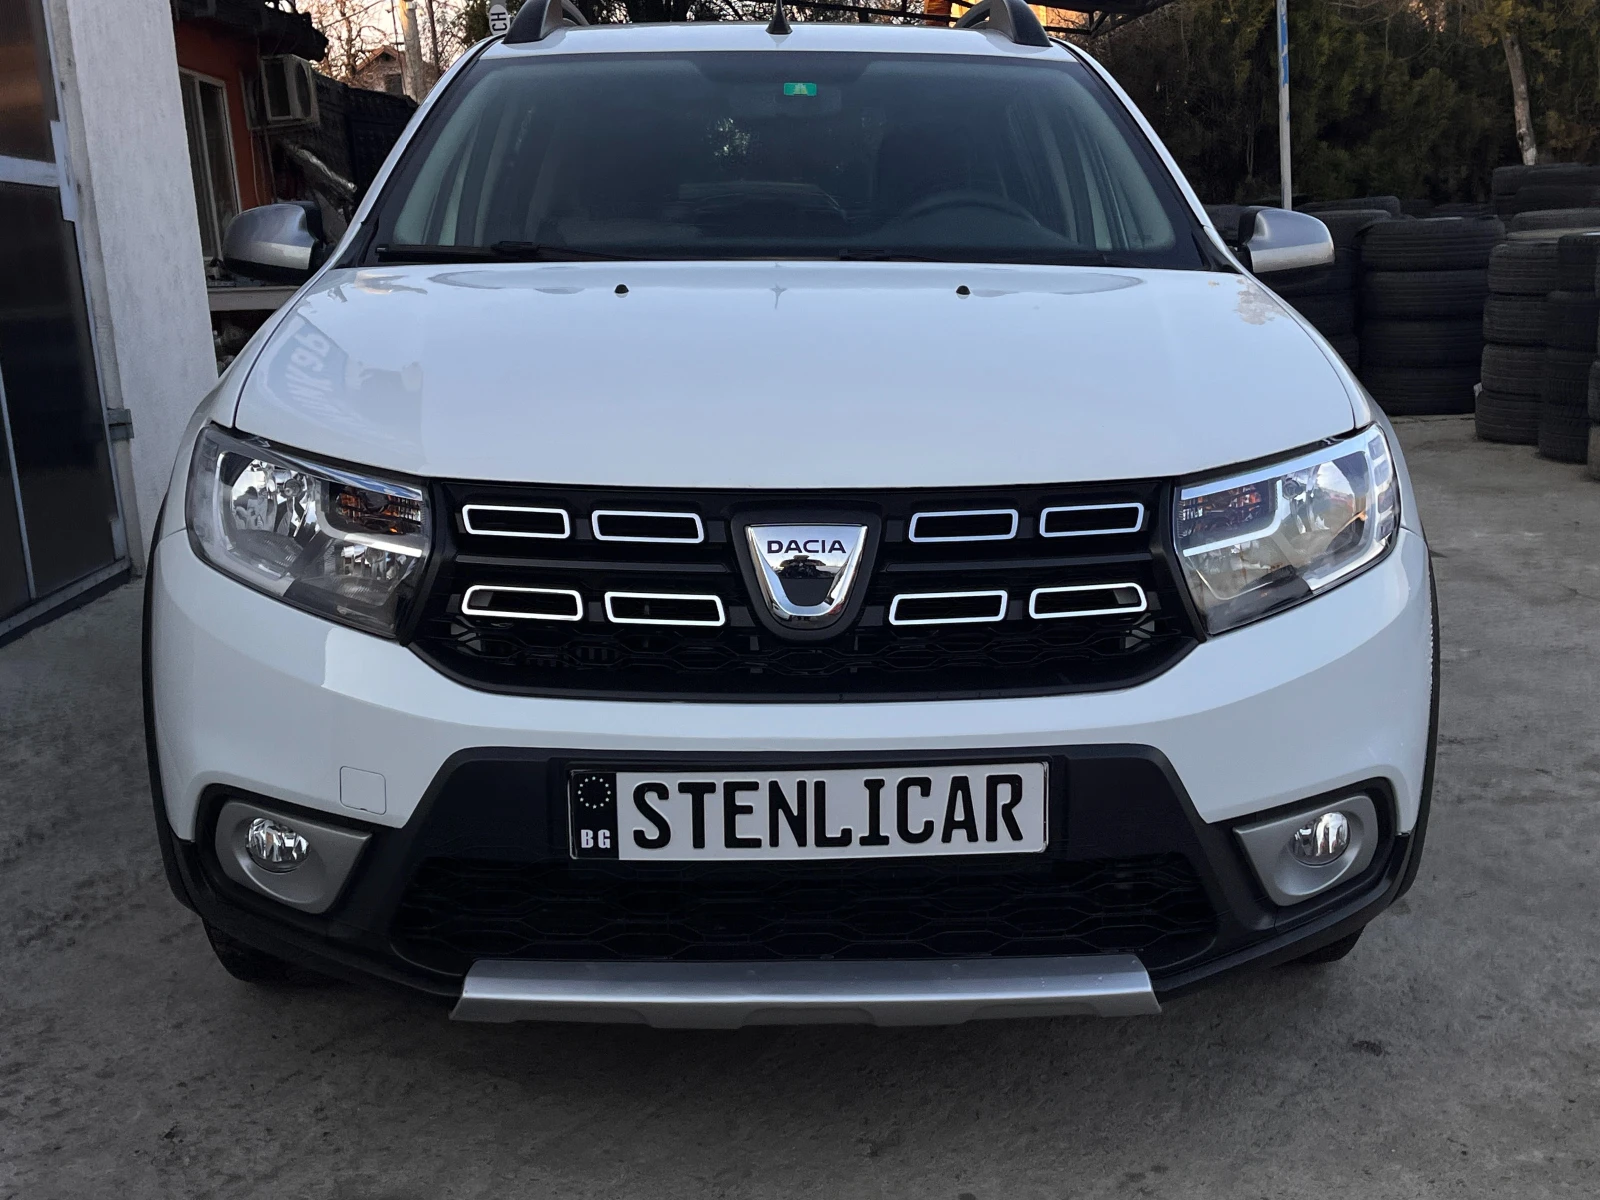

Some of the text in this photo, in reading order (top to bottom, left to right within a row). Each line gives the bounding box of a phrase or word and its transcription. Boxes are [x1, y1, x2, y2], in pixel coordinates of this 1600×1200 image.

[767, 540, 846, 553] DACIA
[632, 774, 1024, 850] STENLICAR
[581, 829, 610, 848] BG
